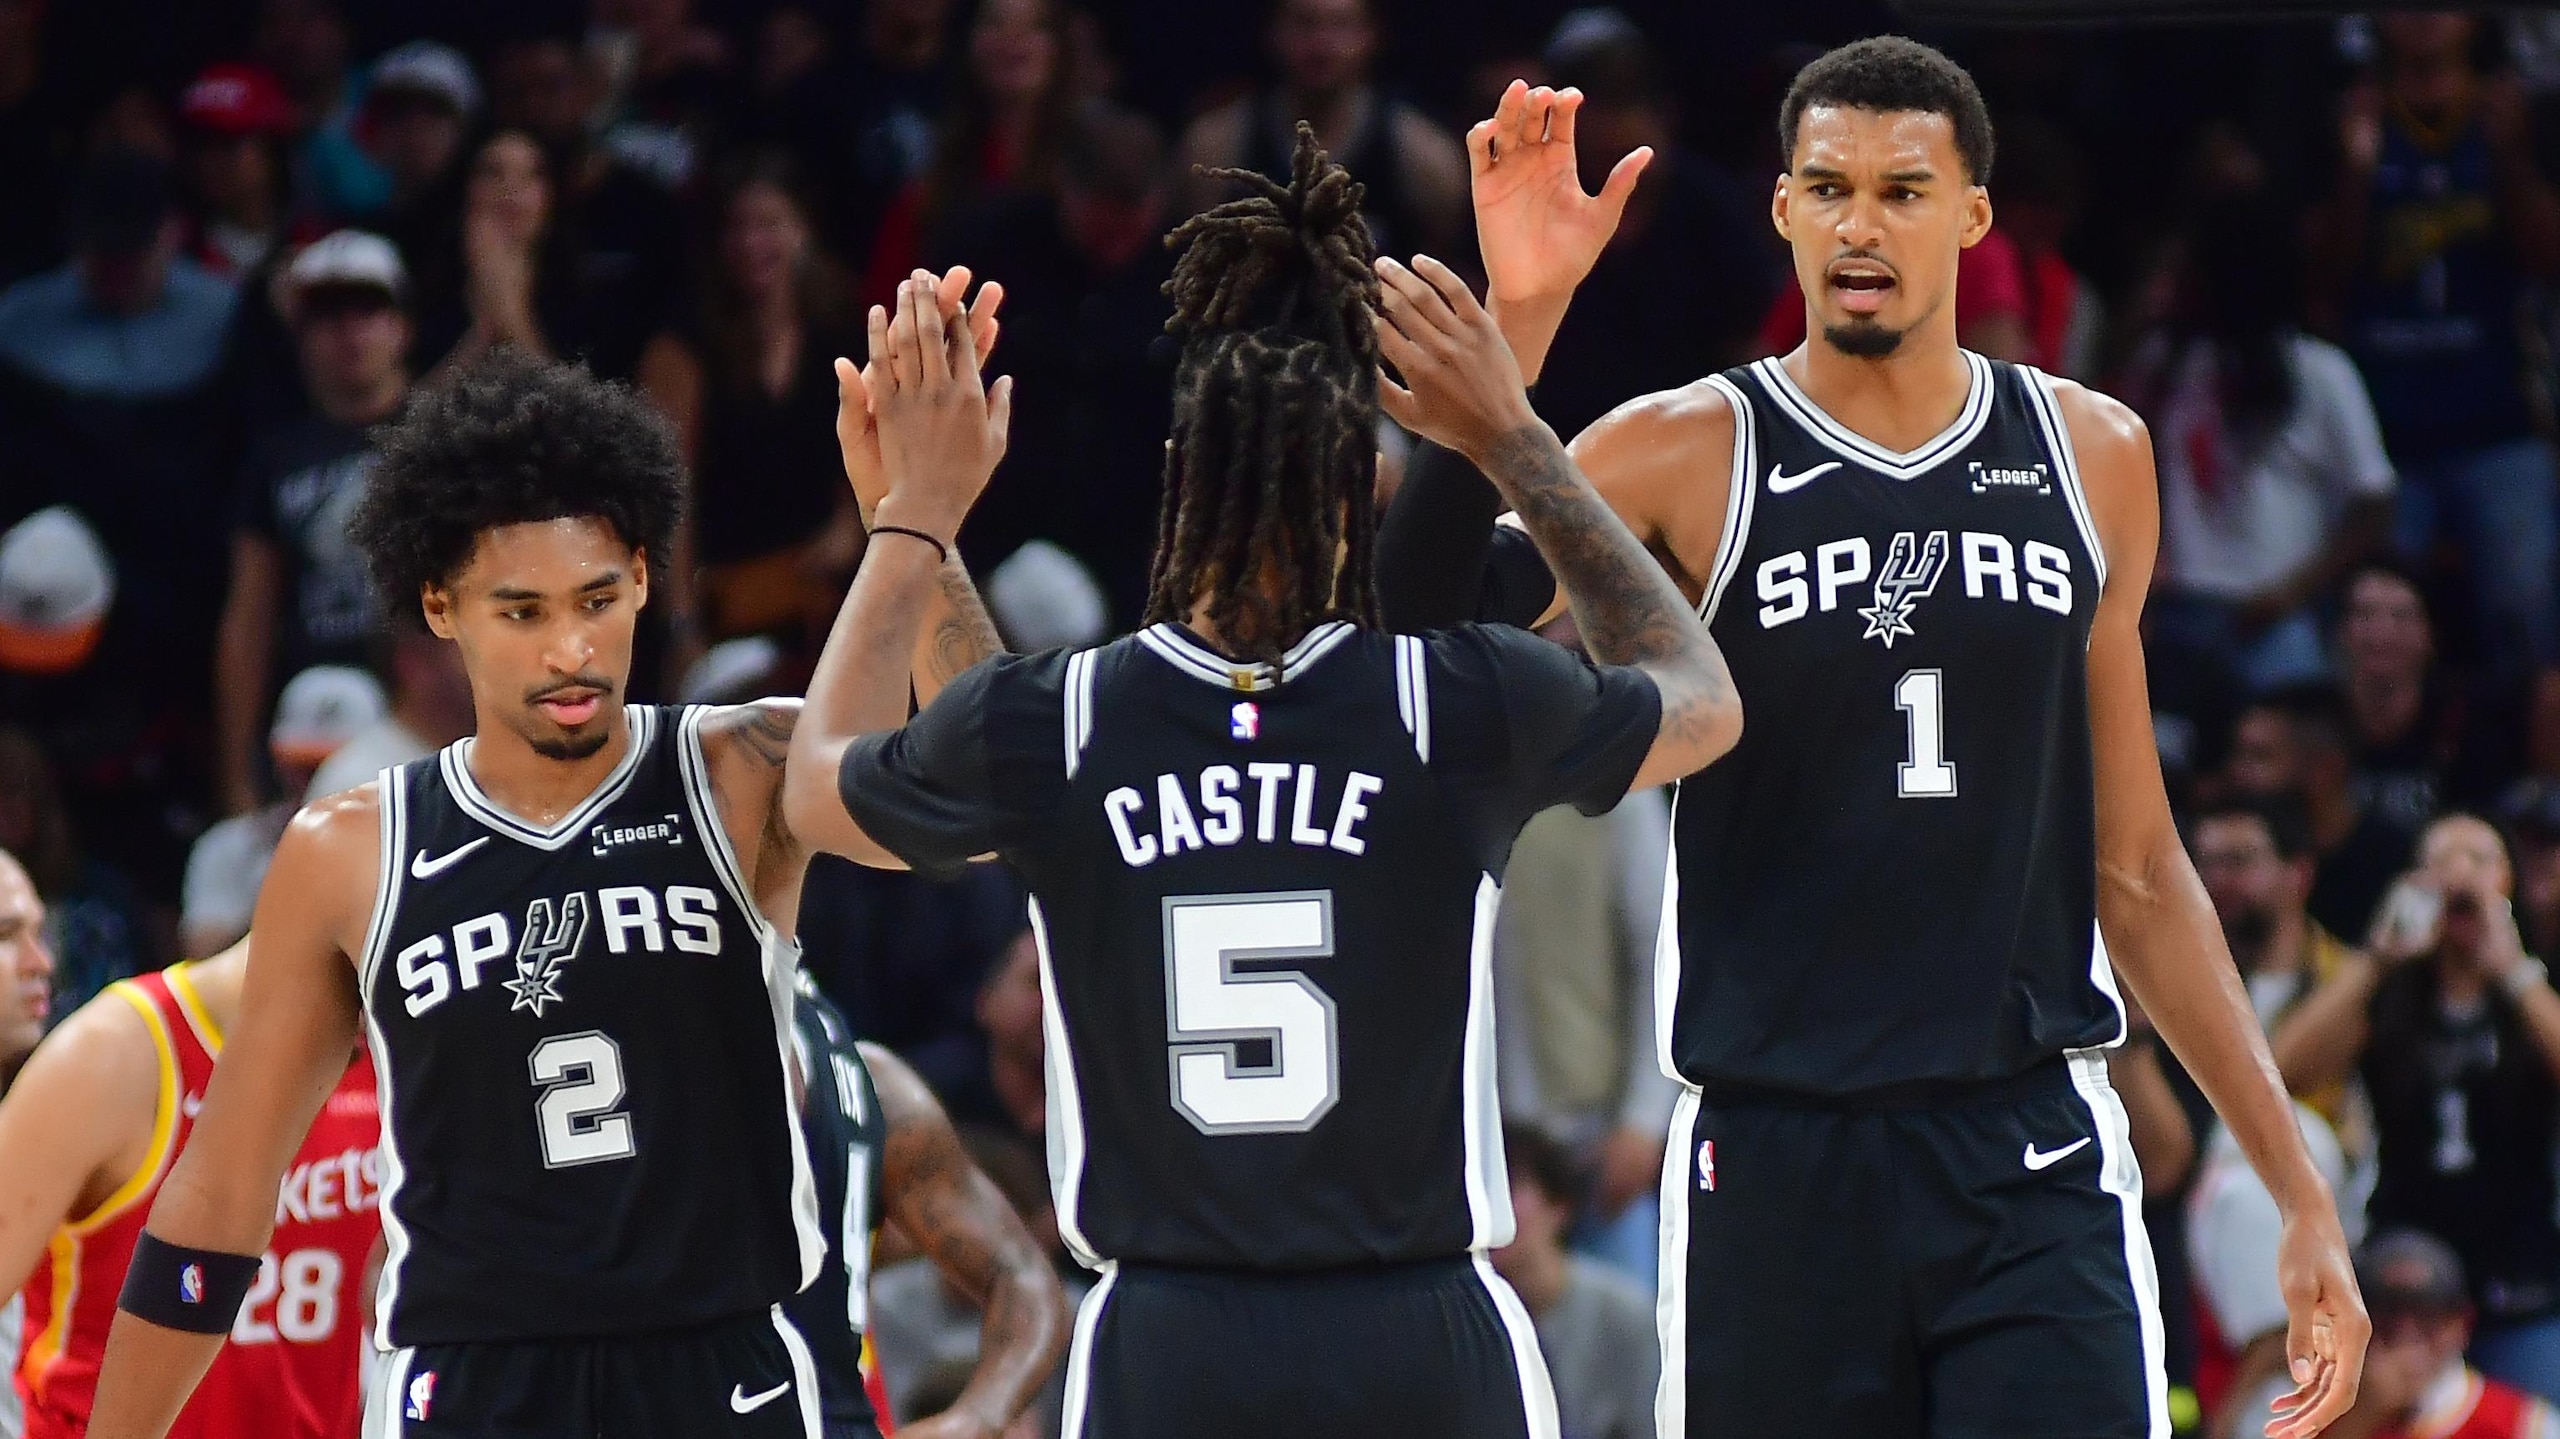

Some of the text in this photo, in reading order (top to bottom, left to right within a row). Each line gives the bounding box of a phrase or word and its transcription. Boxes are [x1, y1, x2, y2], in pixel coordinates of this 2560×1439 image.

[1981, 469, 2040, 486] LEDGER
[1894, 668, 1958, 799] 1
[602, 823, 669, 846] LEDGER
[1103, 762, 1384, 868] CASTLE
[1161, 889, 1341, 1137] 5
[527, 1029, 637, 1170] 2
[275, 1149, 381, 1225] KETS
[230, 1249, 343, 1345] 28
